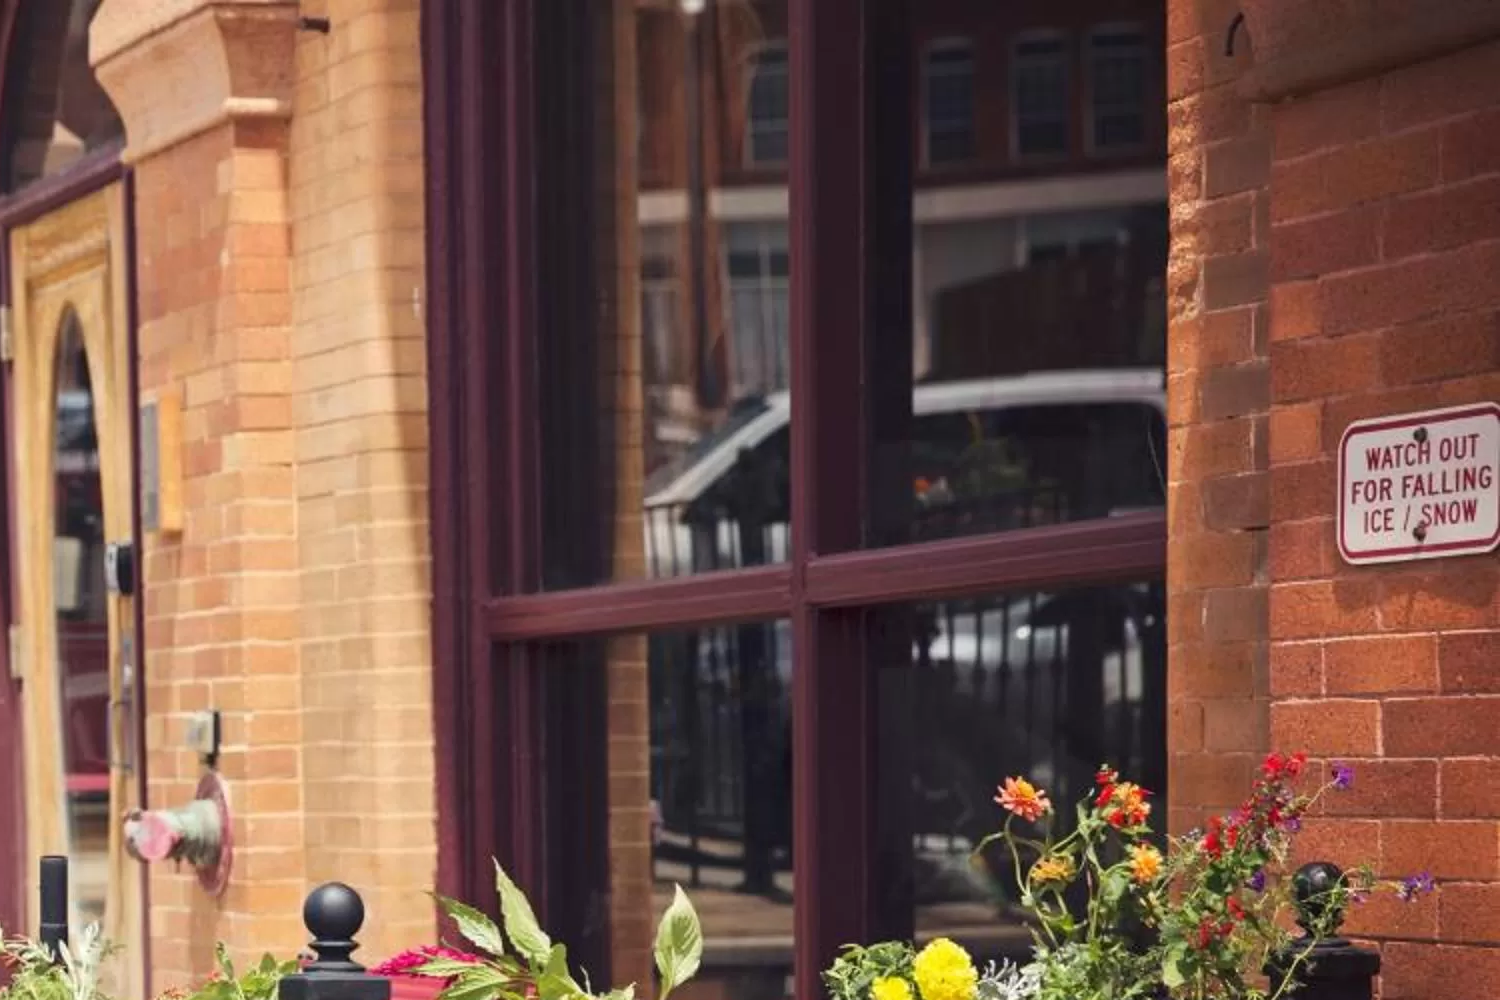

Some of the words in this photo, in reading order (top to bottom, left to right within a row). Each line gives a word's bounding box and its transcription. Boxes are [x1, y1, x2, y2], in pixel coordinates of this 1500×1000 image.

[1366, 440, 1431, 471] WATCH
[1439, 434, 1479, 461] OUT
[1352, 478, 1392, 505] FOR
[1401, 465, 1492, 499] FALLING
[1364, 508, 1395, 533] ICE
[1422, 499, 1478, 527] SNOW
